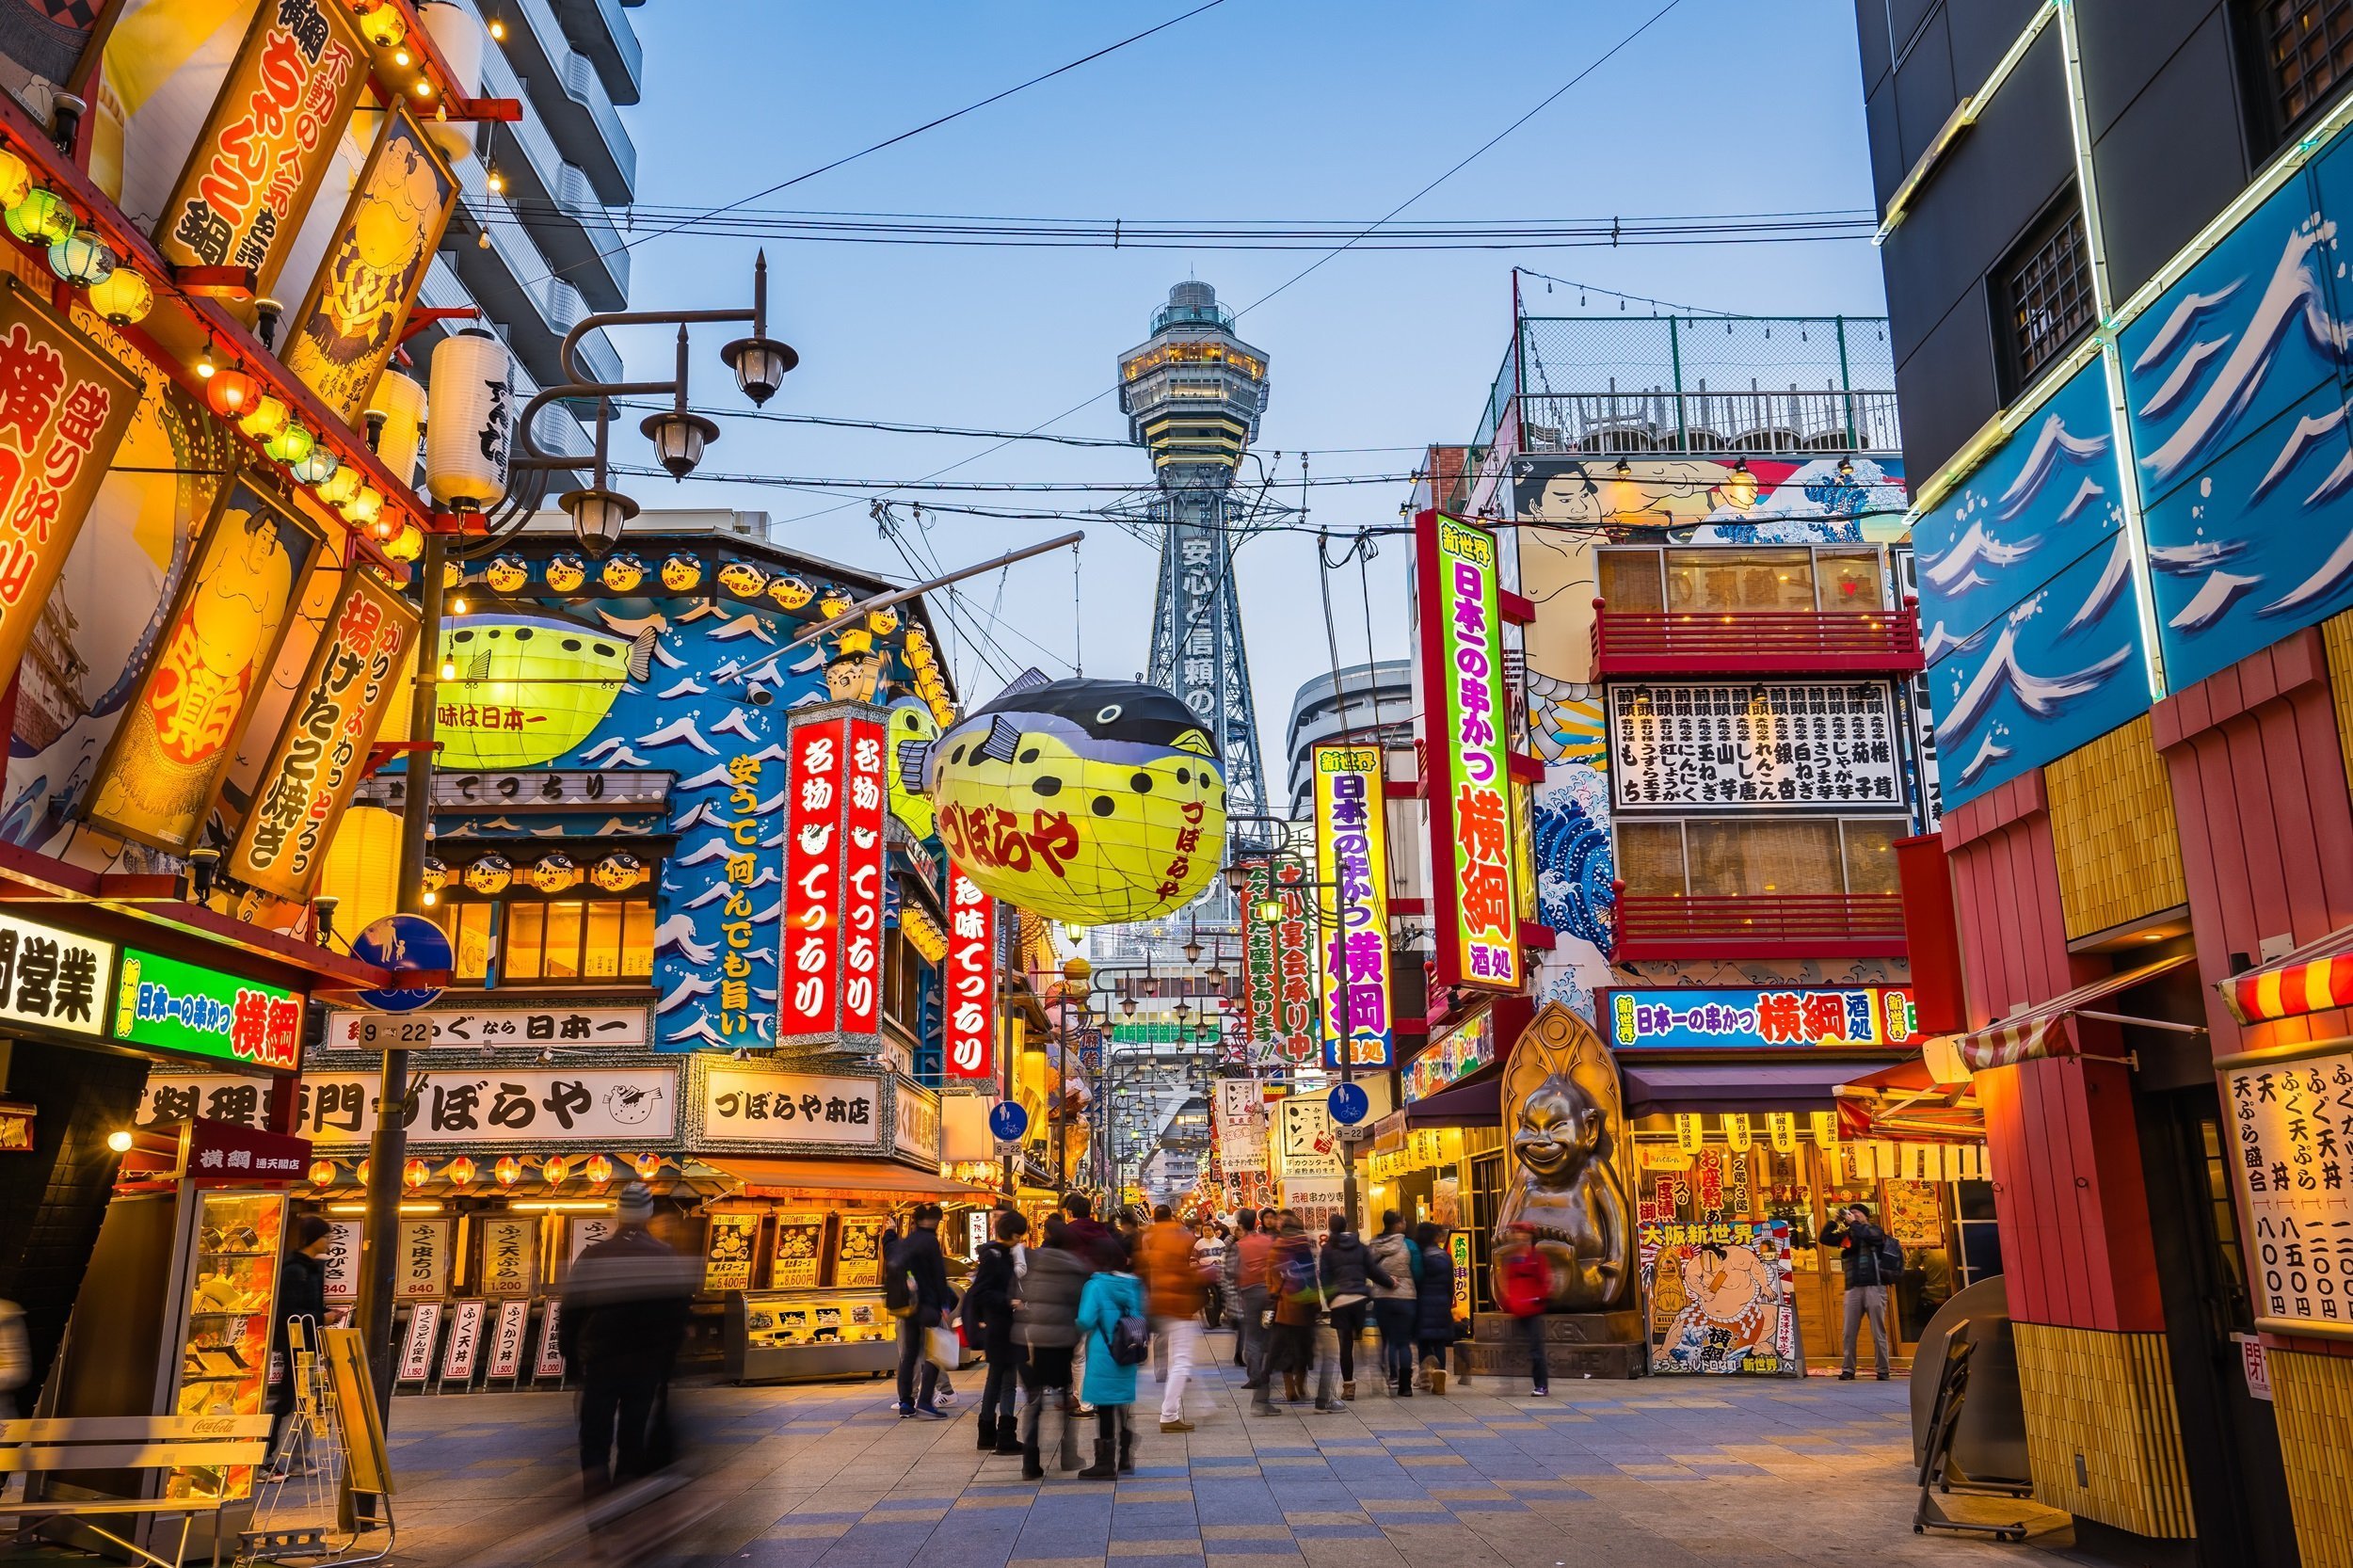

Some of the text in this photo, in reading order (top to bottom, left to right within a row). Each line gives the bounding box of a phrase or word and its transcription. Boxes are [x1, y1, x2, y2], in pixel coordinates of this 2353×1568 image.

[235, 40, 353, 276] 不動の人気を誇
[1441, 524, 1490, 566] 新世界
[1453, 562, 1497, 783] 日本一の串かつ
[1789, 687, 1808, 715] 前頭
[1808, 687, 1827, 715] 前頭
[1827, 687, 1846, 715] 前頭
[438, 704, 548, 731] 味は日本一
[1617, 688, 1636, 716] 前頭
[1637, 688, 1655, 716] 頭
[1656, 688, 1673, 716] 前頭
[1674, 688, 1693, 716] 前頭
[1693, 688, 1712, 716] 前頭
[1713, 688, 1732, 716] 前頭
[1732, 688, 1751, 716] 前頭
[1751, 688, 1769, 715] 頭
[1769, 688, 1788, 715] 前頭
[802, 738, 835, 812] 名物
[854, 737, 881, 810] 名物
[1320, 751, 1377, 772] 新世界
[1621, 744, 1641, 802] もち
[1658, 744, 1681, 801] 紅しょうが
[1678, 744, 1698, 802] にんにく
[1698, 744, 1720, 802] 玉ねぎ
[1717, 743, 1737, 801] 山芋
[1737, 743, 1757, 801] しし唐
[1755, 743, 1777, 801] れんこん
[1774, 742, 1797, 800] 銀杏
[1794, 742, 1816, 800] 白ねぎ
[1814, 742, 1834, 800] さつま芋
[1833, 742, 1854, 800] じゃが芋
[1851, 742, 1873, 799] 茄子
[1871, 741, 1893, 799] 椎茸
[941, 800, 1080, 878] づぼらや
[1156, 800, 1208, 902] づぼらや
[1457, 786, 1512, 938] 横綱
[719, 754, 762, 1035] 安うて何んでも旨い
[1327, 932, 1385, 1036] 横綱
[1469, 943, 1512, 980] 酒処
[118, 958, 141, 1036] 新世界
[136, 983, 232, 1036] 日本一の串かつ
[1616, 991, 1874, 1046] 新世界 日本一の串かつ 横綱 酒処
[1885, 992, 1909, 1042] 新世界
[231, 986, 301, 1066] 横綱
[1337, 1039, 1385, 1064] 酒処
[714, 1090, 871, 1125] づぼらや本店
[2233, 1076, 2267, 1192] 天ぷら盛合
[2256, 1073, 2291, 1192] 天丼
[2281, 1071, 2317, 1191] ふぐ天ぷら
[2307, 1067, 2344, 1191] ふぐ天丼
[200, 1148, 251, 1170] 横綱
[411, 1224, 434, 1280] ふぐ皮ちり
[1642, 1224, 1755, 1245] 大阪新世界
[408, 1284, 434, 1293] 840
[1453, 1236, 1468, 1302] 本場の串かつ
[410, 1307, 433, 1364] ふぐうどん定食
[455, 1307, 476, 1363] ふぐ天丼
[500, 1306, 520, 1362] ふぐかつ丼
